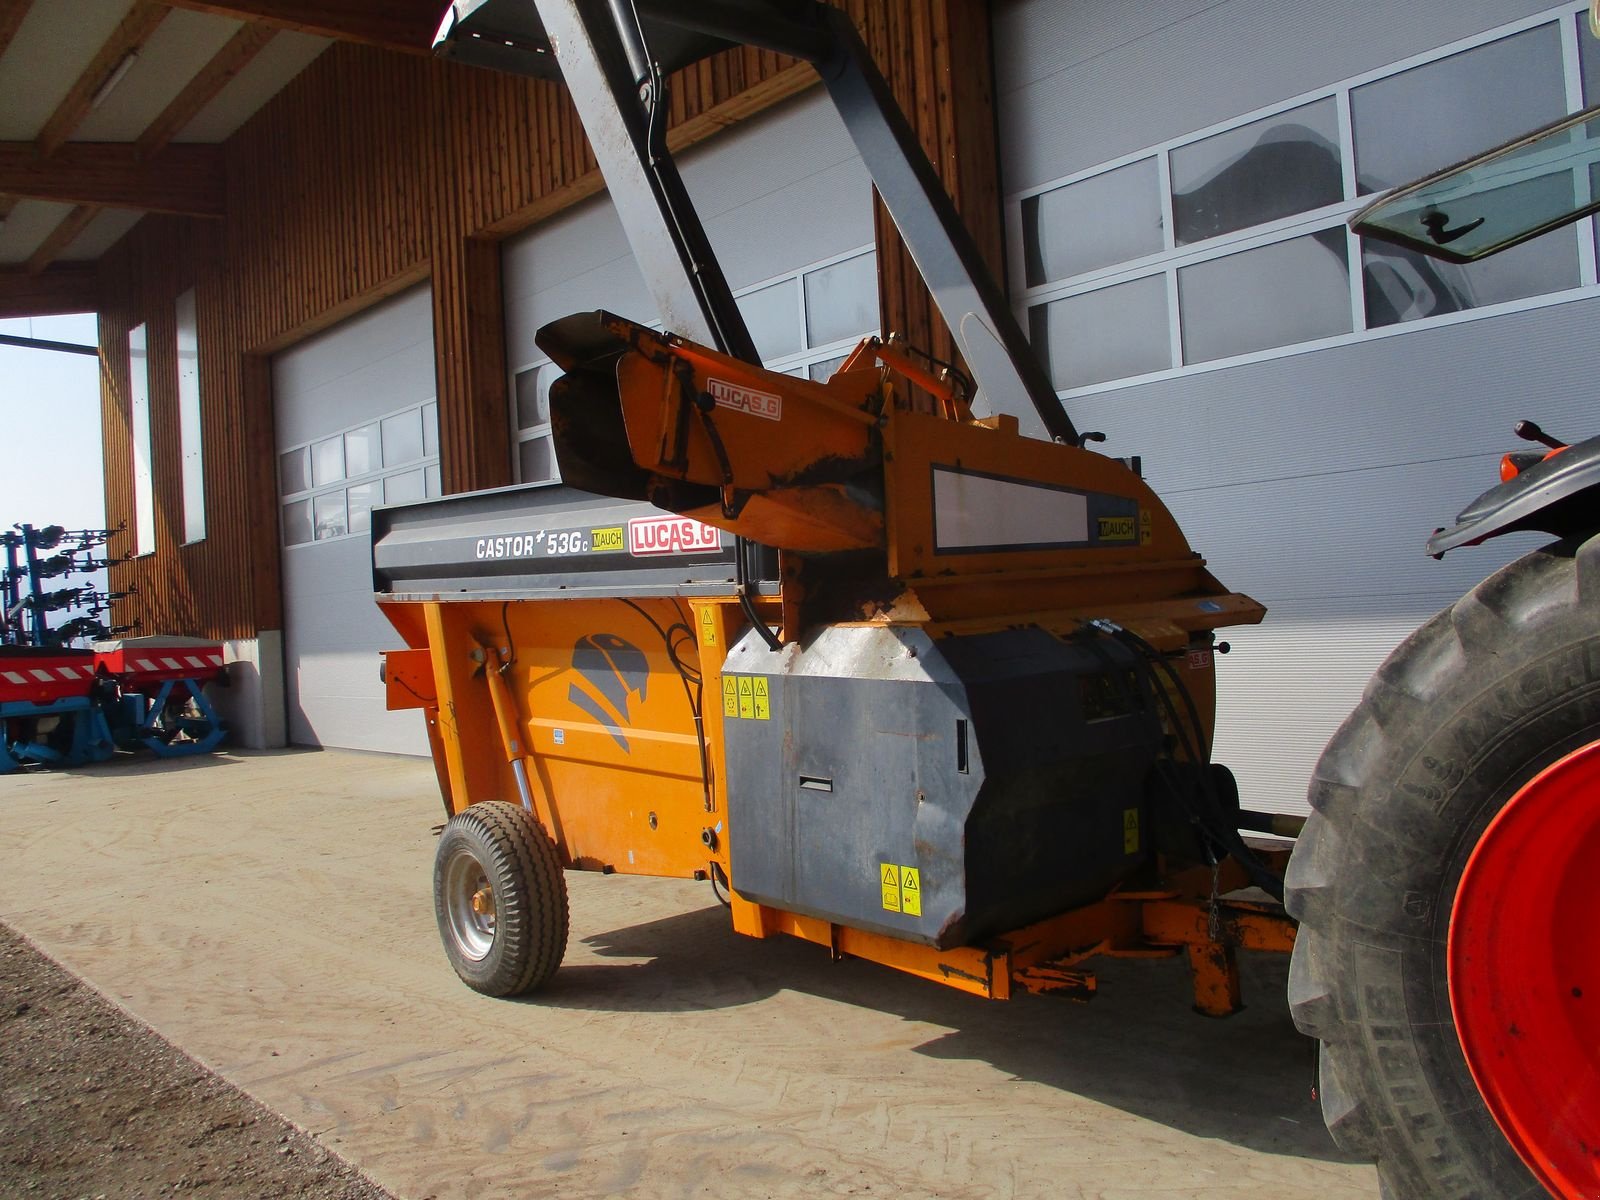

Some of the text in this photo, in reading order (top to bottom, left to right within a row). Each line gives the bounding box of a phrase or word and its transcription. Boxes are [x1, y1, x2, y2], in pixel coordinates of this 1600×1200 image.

[711, 383, 777, 414] LUCAS.G
[592, 531, 622, 548] MAUCH
[634, 522, 715, 554] LUCAS.G
[1098, 520, 1134, 537] MAUCH
